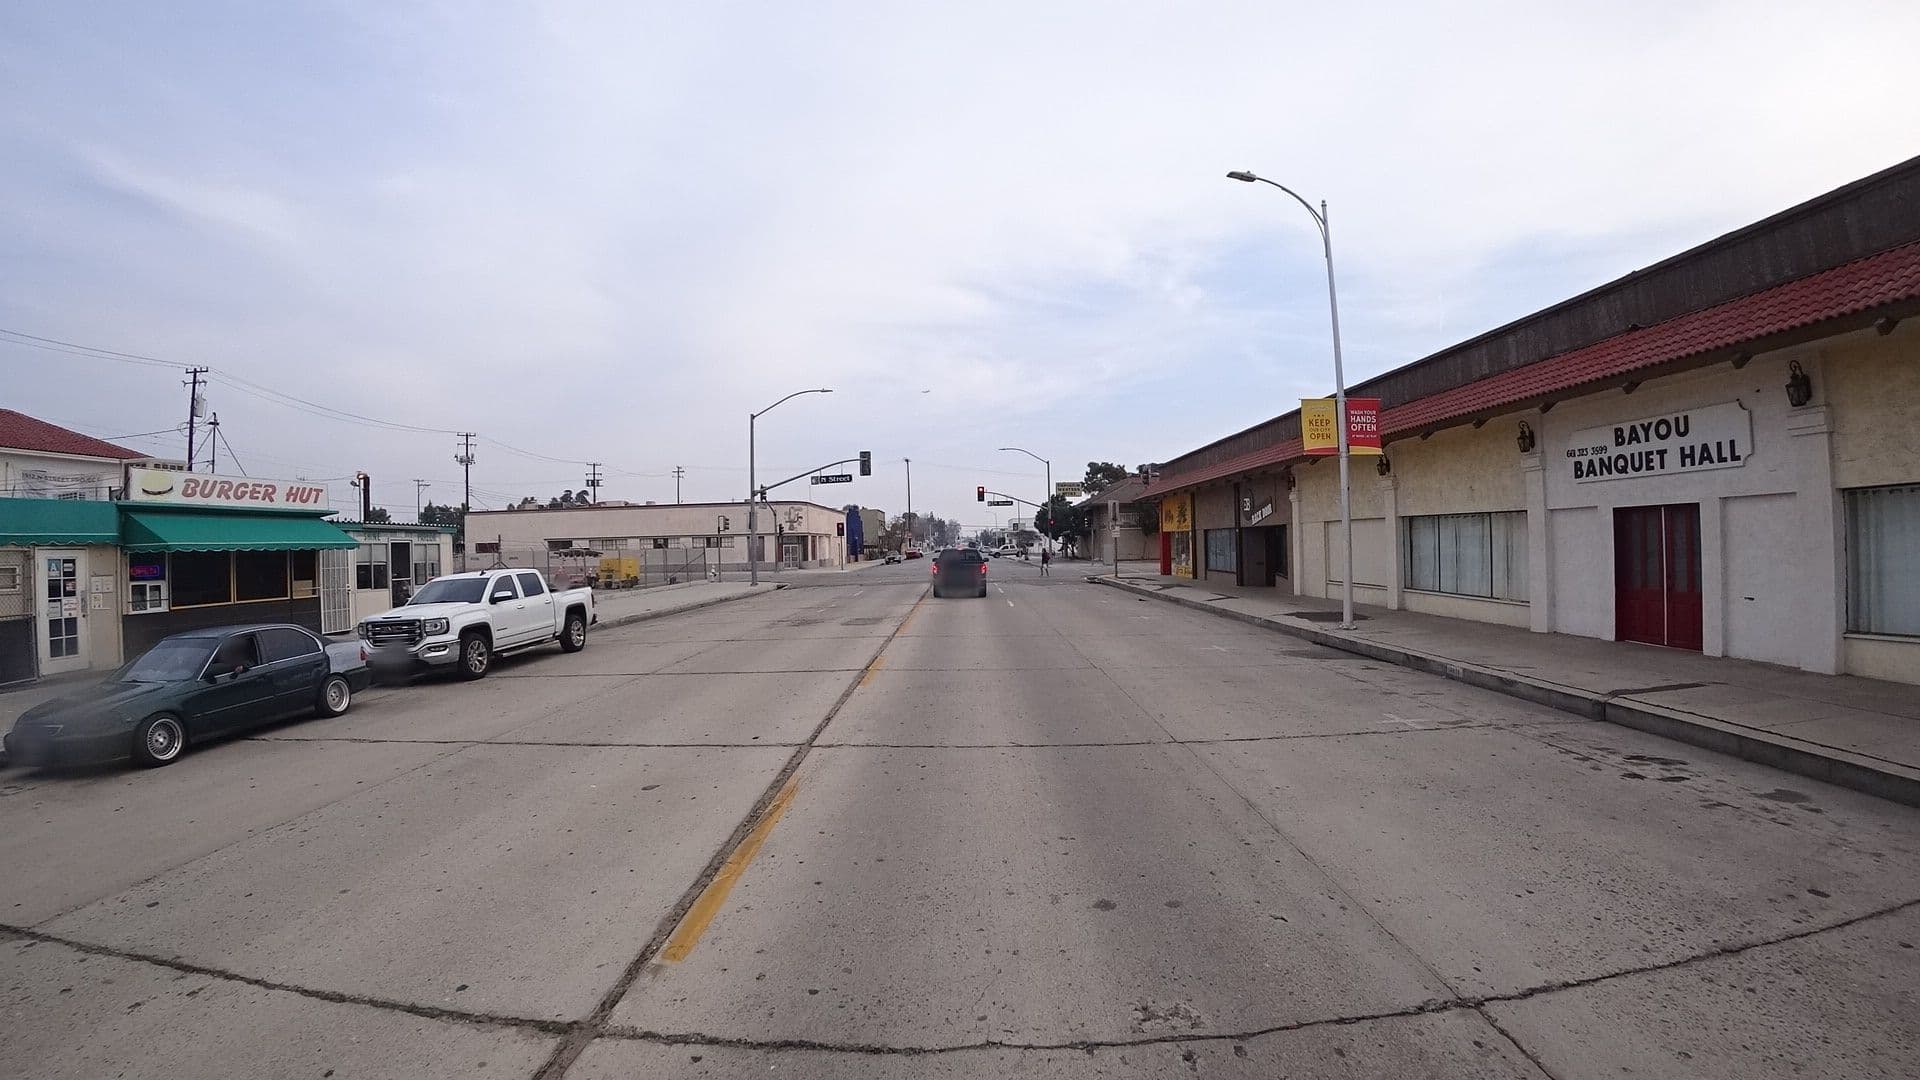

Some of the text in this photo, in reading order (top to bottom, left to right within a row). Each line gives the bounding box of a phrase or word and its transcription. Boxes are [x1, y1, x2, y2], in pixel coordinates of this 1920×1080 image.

[1308, 419, 1331, 427] KEEP
[1350, 423, 1377, 431] OFTEN
[1613, 415, 1690, 447] BAYOU
[1573, 439, 1742, 479] BANQUET HALL
[181, 478, 324, 504] BURGER HUT
